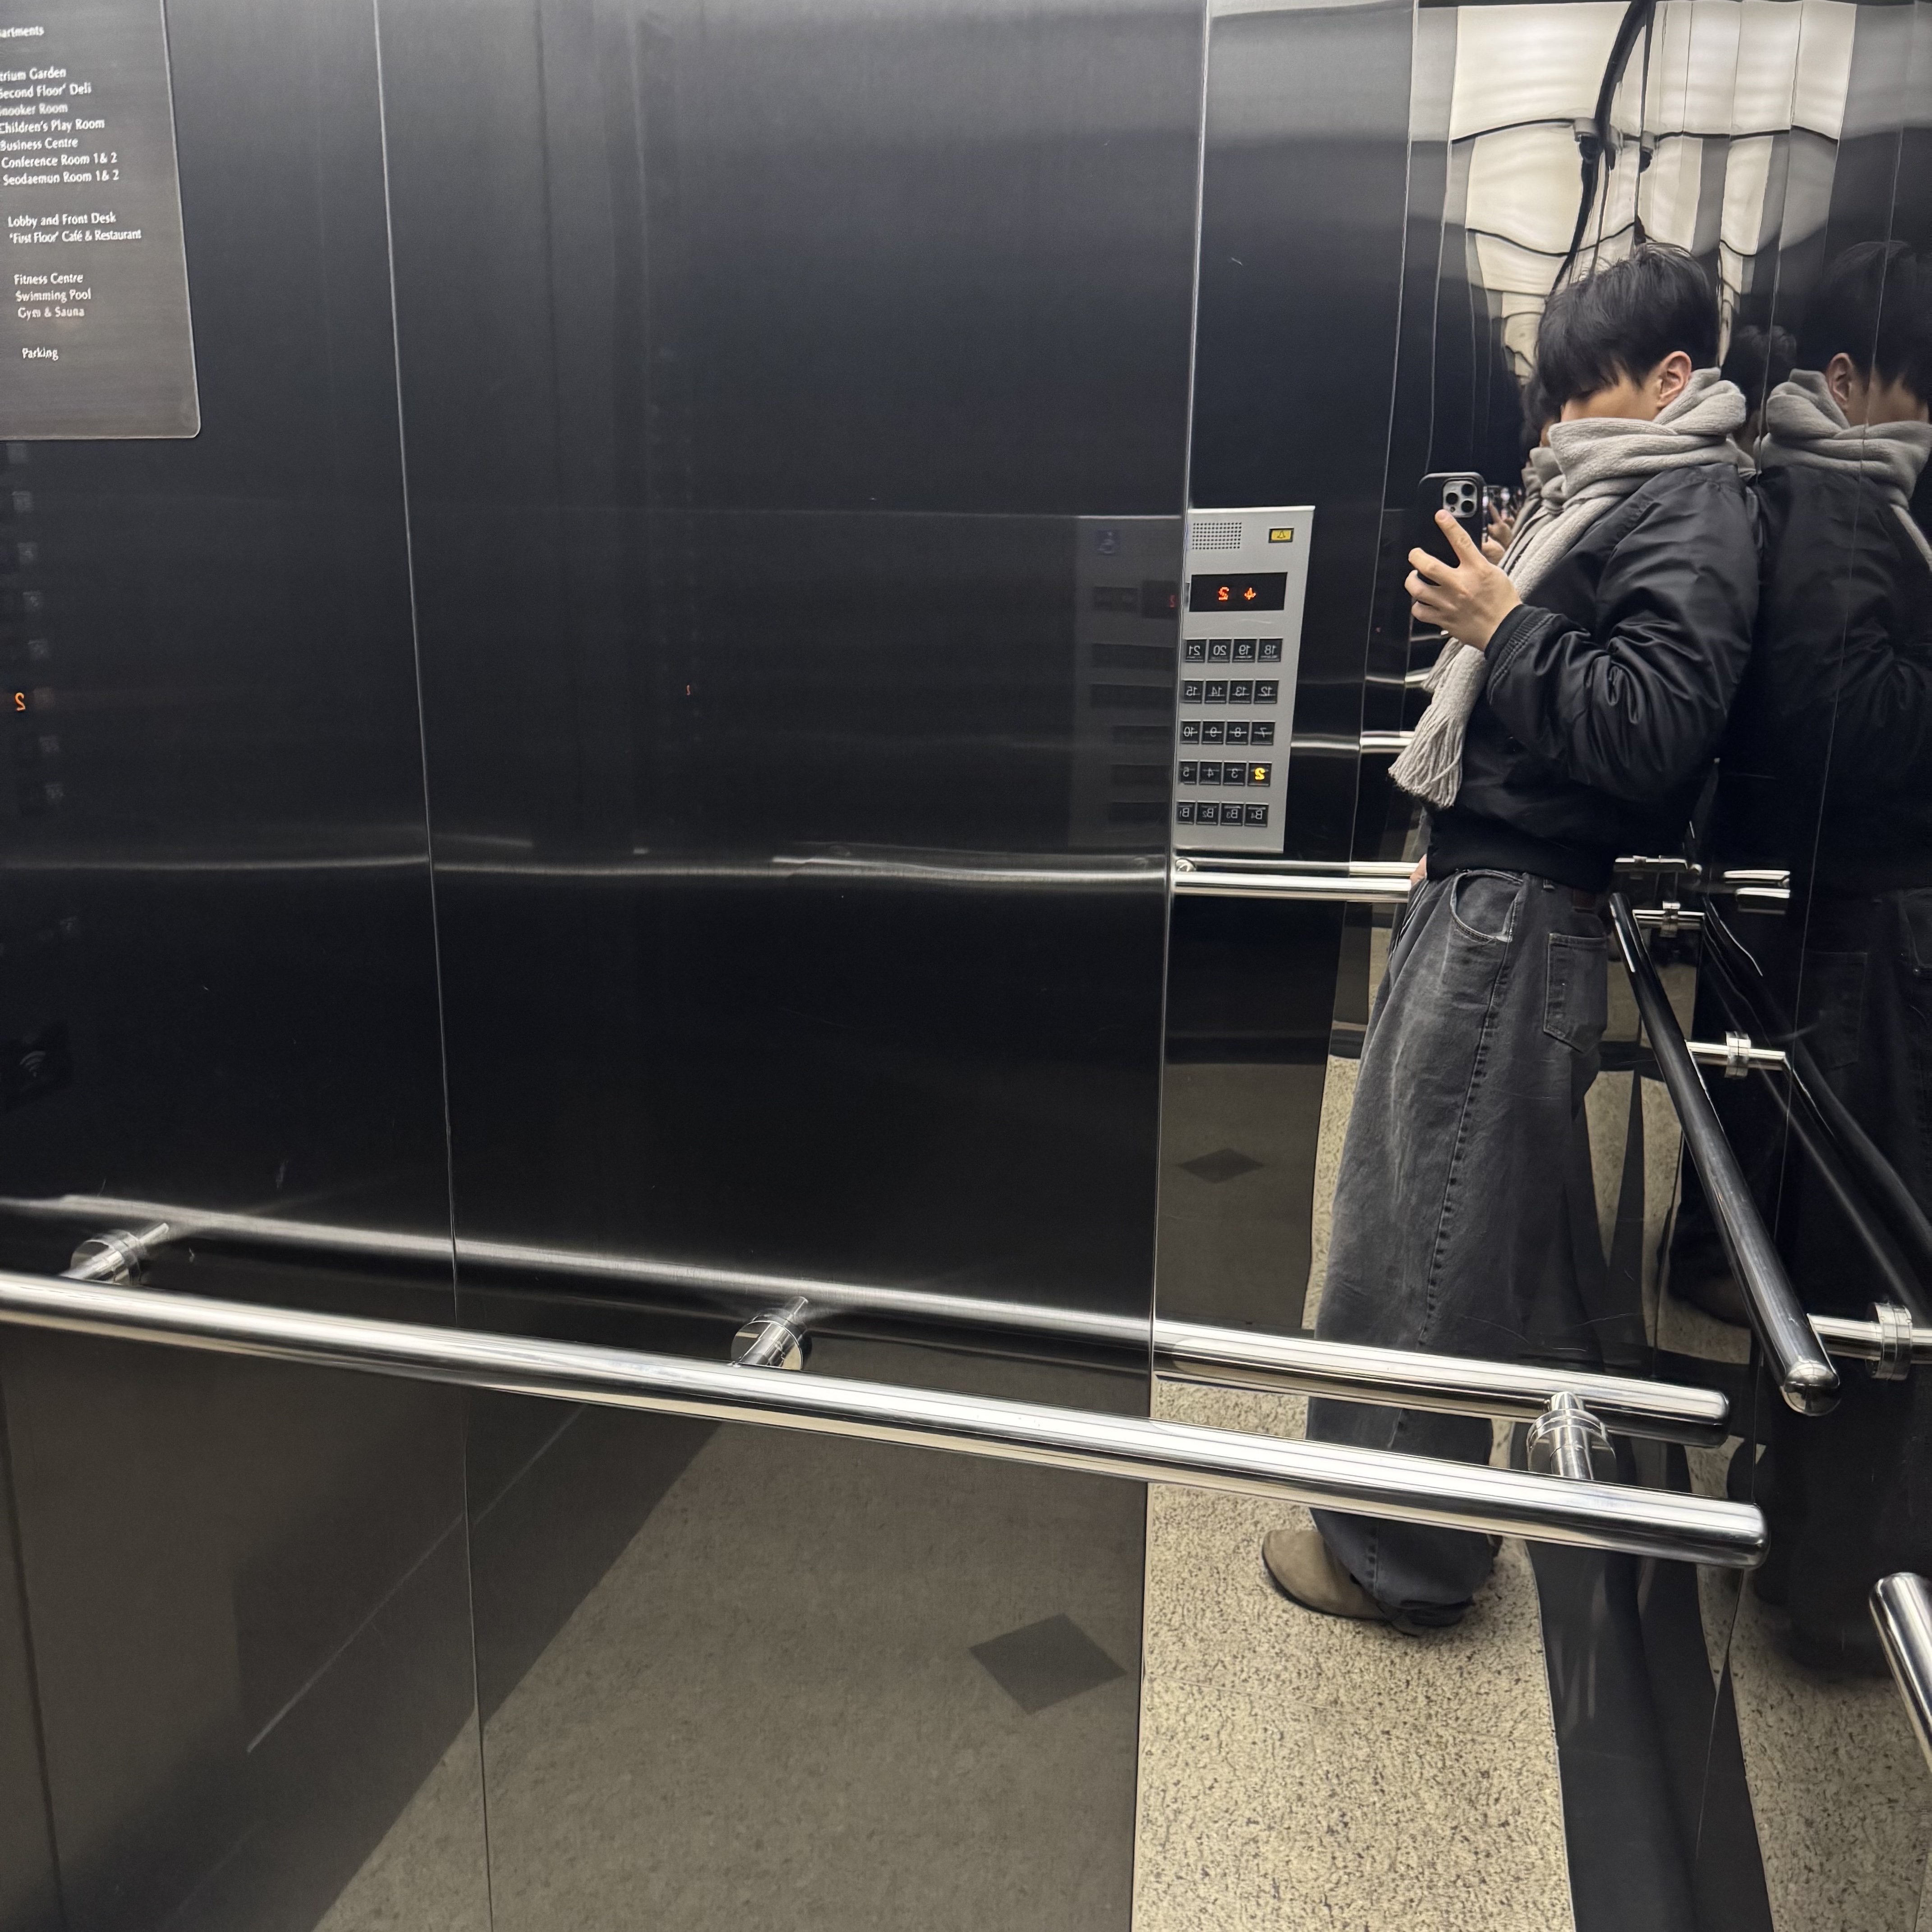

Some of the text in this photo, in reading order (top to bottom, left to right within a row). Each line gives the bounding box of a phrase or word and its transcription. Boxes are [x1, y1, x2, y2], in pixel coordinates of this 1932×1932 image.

[29, 66, 66, 80] Garden
[69, 82, 92, 95] Deli
[0, 103, 68, 116] nooker Room
[51, 119, 72, 133] Play
[75, 118, 105, 130] Room
[0, 137, 78, 151] Business Centre
[1, 156, 58, 169] Conference
[60, 154, 90, 166] Room
[110, 152, 117, 163] 2
[3, 172, 60, 186] Seodaemun
[63, 171, 92, 183] Room
[112, 169, 119, 181] 2
[8, 211, 116, 230] Lobby and Front Desk
[61, 230, 83, 242] Café
[84, 230, 92, 241] &
[94, 229, 142, 241] Restaurant
[14, 272, 83, 285] Fitness Centre
[15, 288, 91, 304] Swimming Pool
[18, 306, 85, 321] Gym & Sauna
[22, 347, 59, 361] Parking
